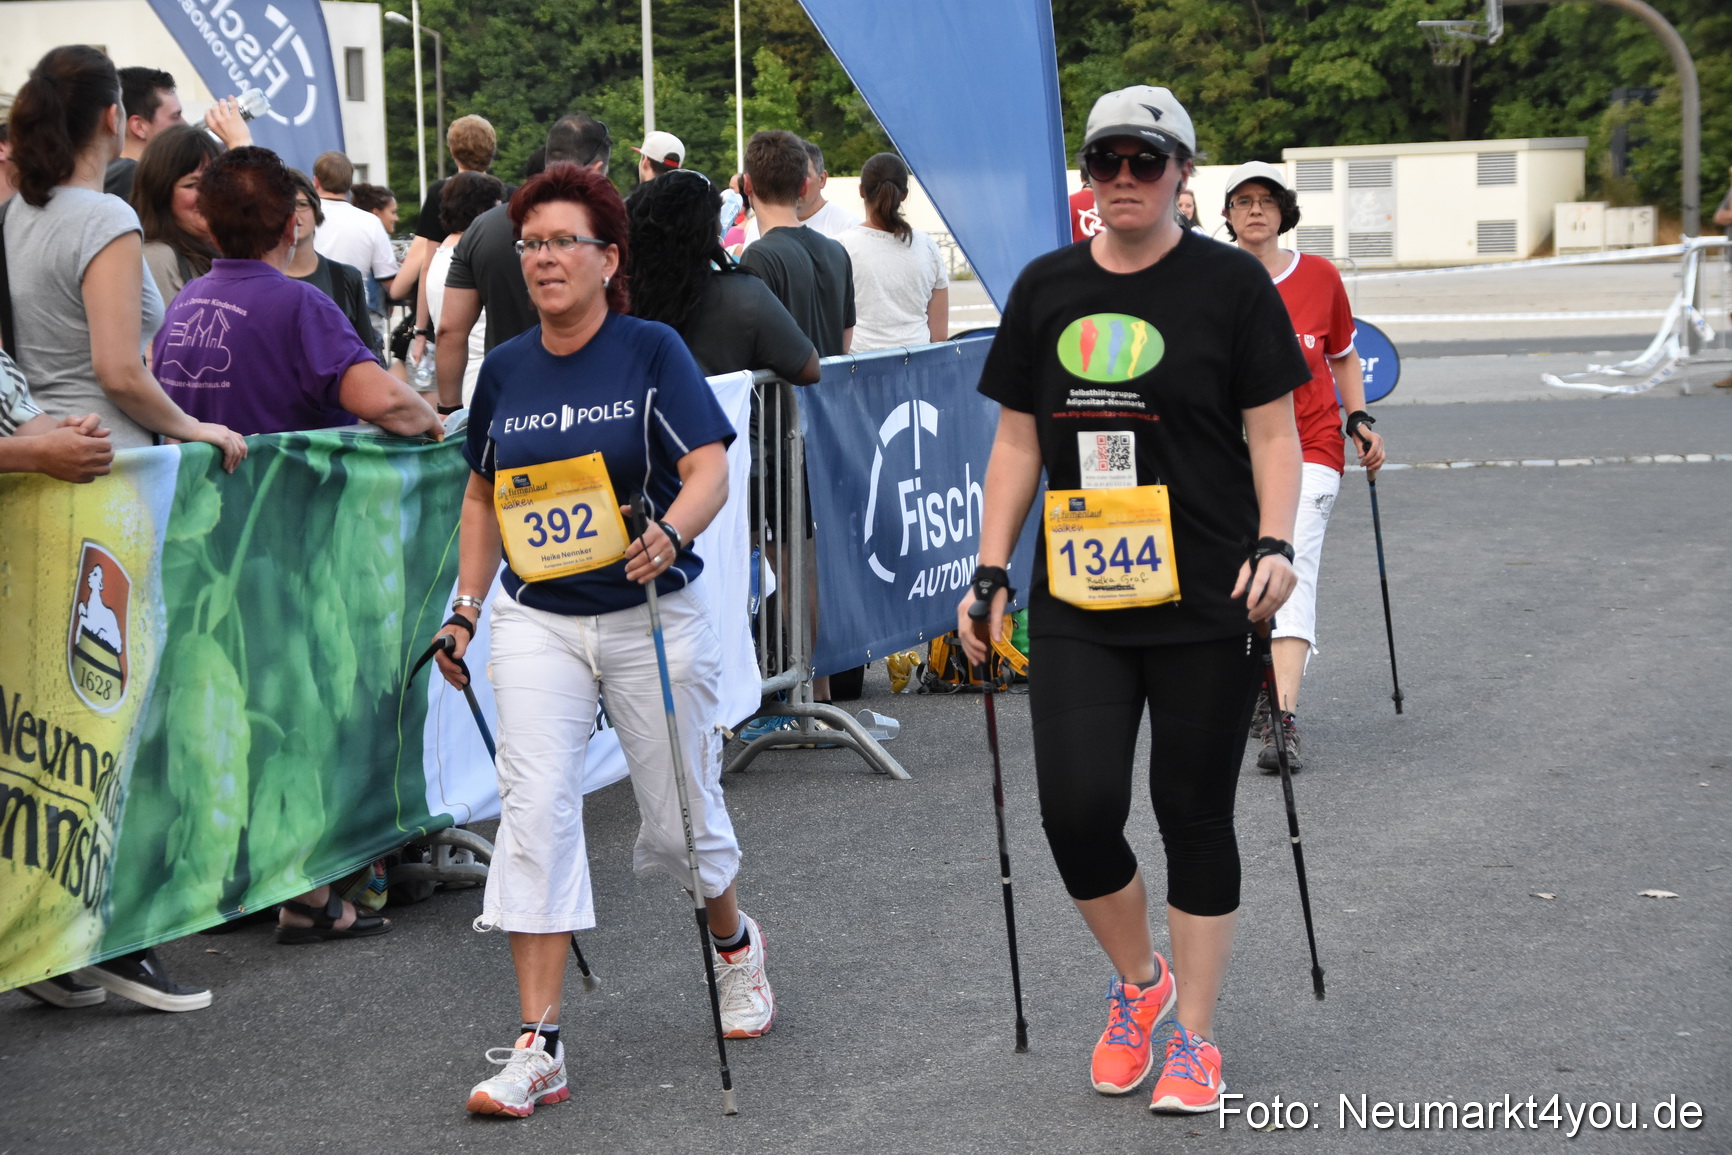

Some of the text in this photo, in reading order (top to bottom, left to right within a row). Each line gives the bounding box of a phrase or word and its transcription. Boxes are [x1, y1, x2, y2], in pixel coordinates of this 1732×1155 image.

[504, 400, 635, 433] EURO POLES
[523, 502, 599, 548] 392
[541, 553, 561, 563] Heike
[561, 547, 592, 559] Nennker
[1060, 535, 1162, 576] 1344
[80, 666, 112, 700] 1628
